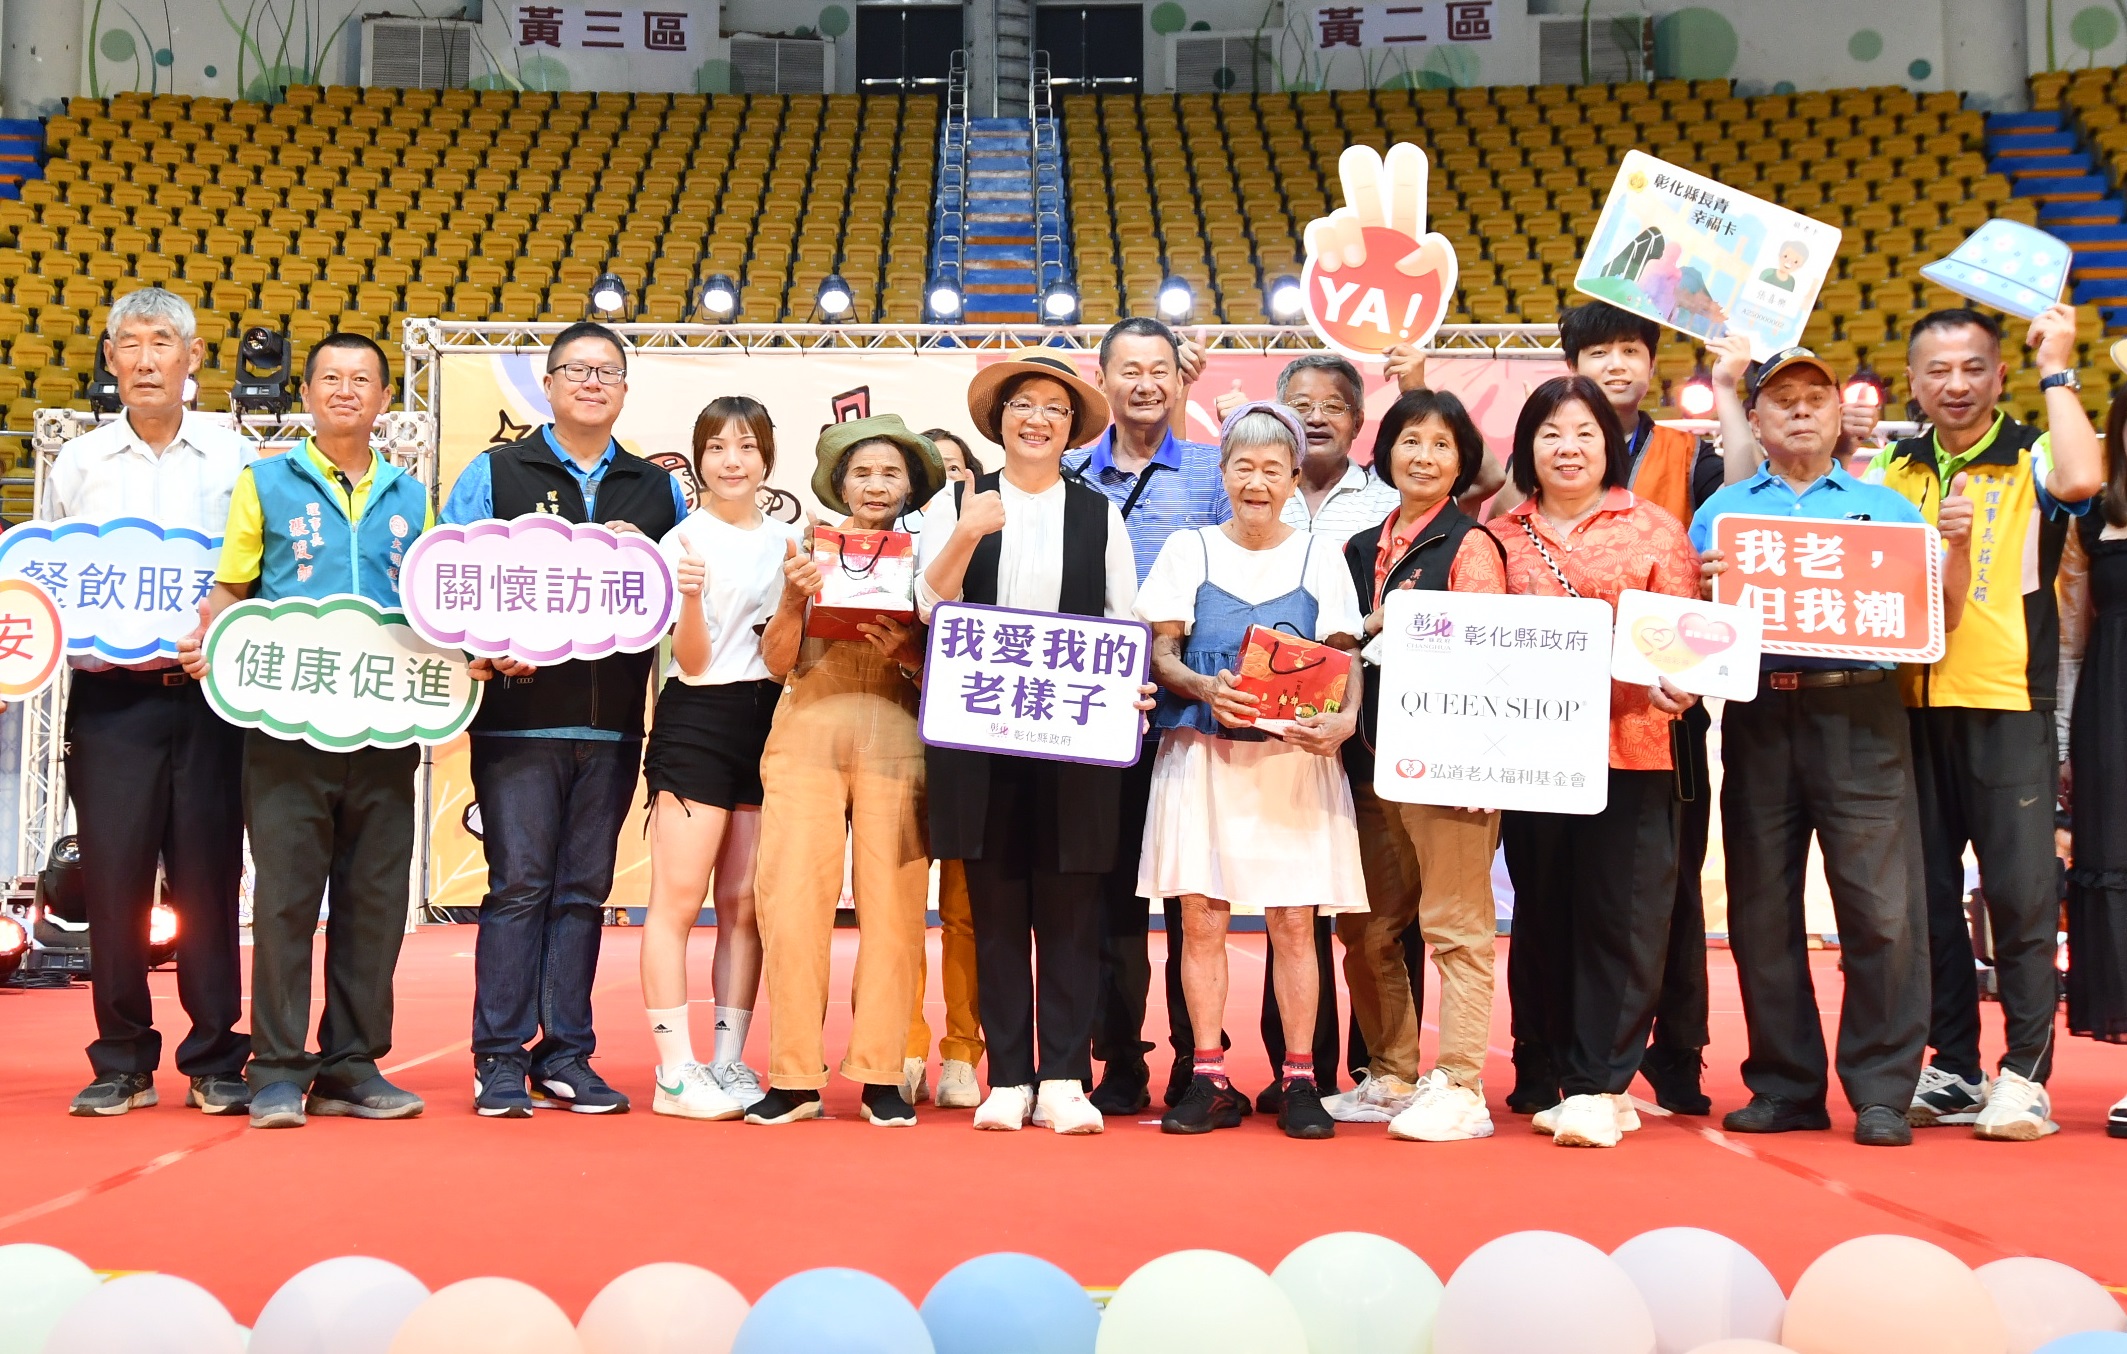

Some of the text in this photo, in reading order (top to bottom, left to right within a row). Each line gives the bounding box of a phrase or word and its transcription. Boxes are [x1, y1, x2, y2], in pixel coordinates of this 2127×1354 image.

[519, 6, 688, 51] 黃三區
[1319, 1, 1492, 48] 黃二區
[1653, 173, 1730, 214] 彰化縣長青
[1690, 209, 1738, 236] 幸福卡
[1317, 276, 1423, 339] YA!
[1735, 529, 1884, 580] 我老，
[435, 563, 649, 616] 關懷訪視
[1736, 583, 1905, 639] 但我潮
[941, 616, 1138, 678] 我愛我的
[1464, 625, 1589, 652] 彰化縣政府
[234, 638, 453, 708] 健康促進
[960, 671, 1107, 726] 老樣子
[1401, 691, 1499, 718] QUEEN
[1014, 729, 1072, 747] 彰化縣政府
[1430, 763, 1587, 788] 弘道老人福利基金會
